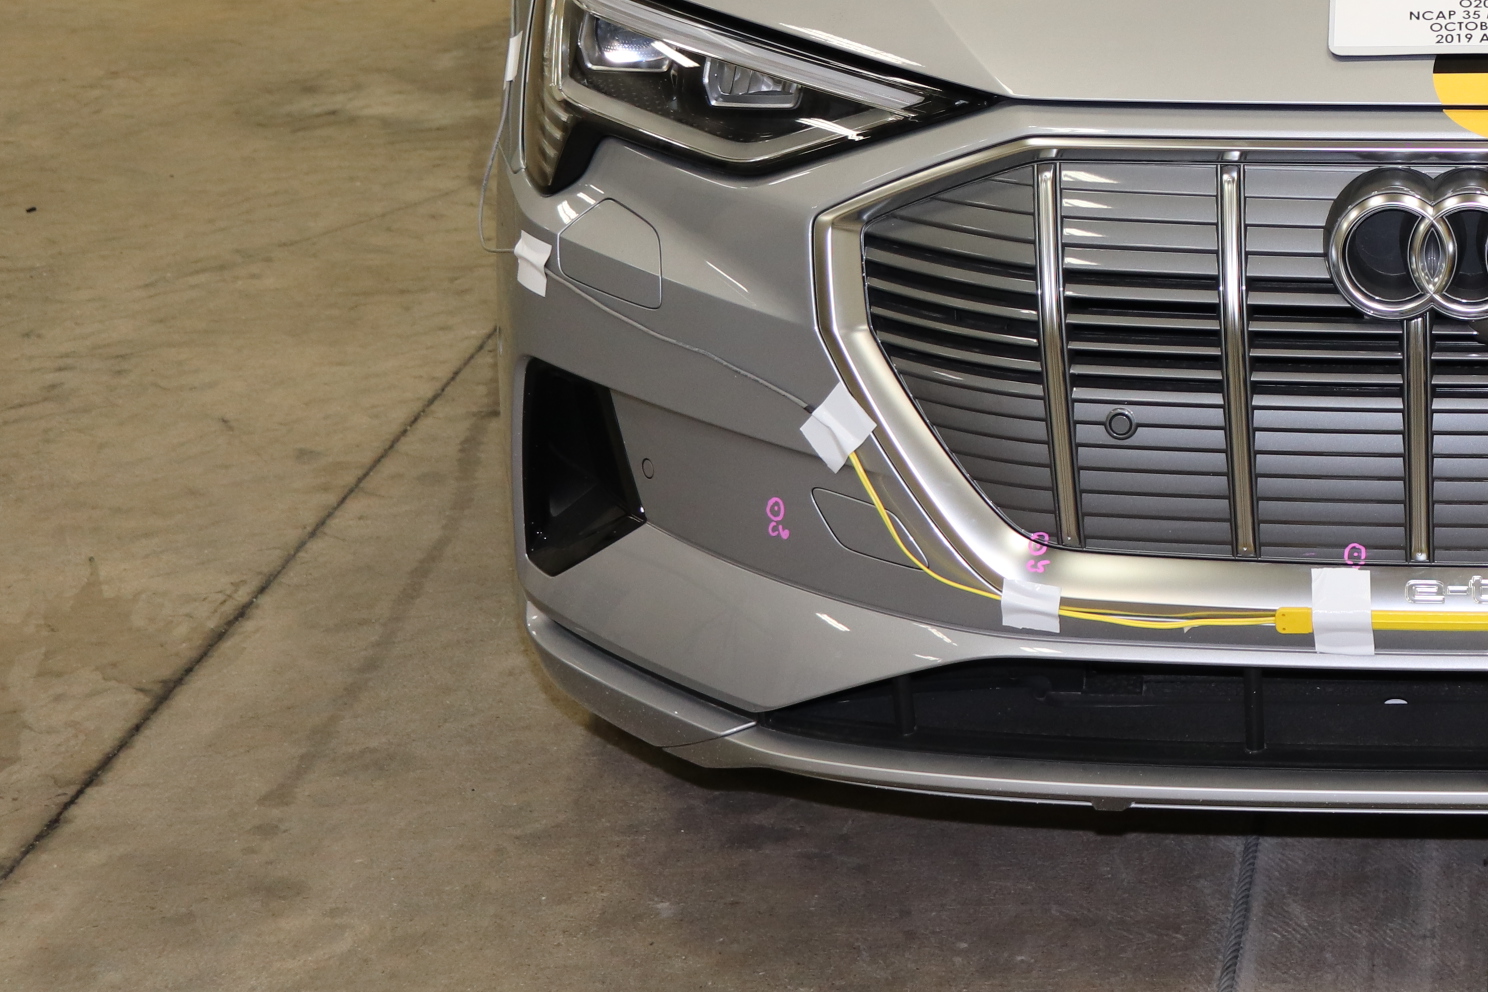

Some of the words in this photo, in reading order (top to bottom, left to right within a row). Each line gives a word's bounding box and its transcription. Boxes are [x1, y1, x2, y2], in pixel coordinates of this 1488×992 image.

[1409, 10, 1456, 20] NCAP
[1462, 10, 1481, 19] 35
[1435, 34, 1473, 44] 2019
